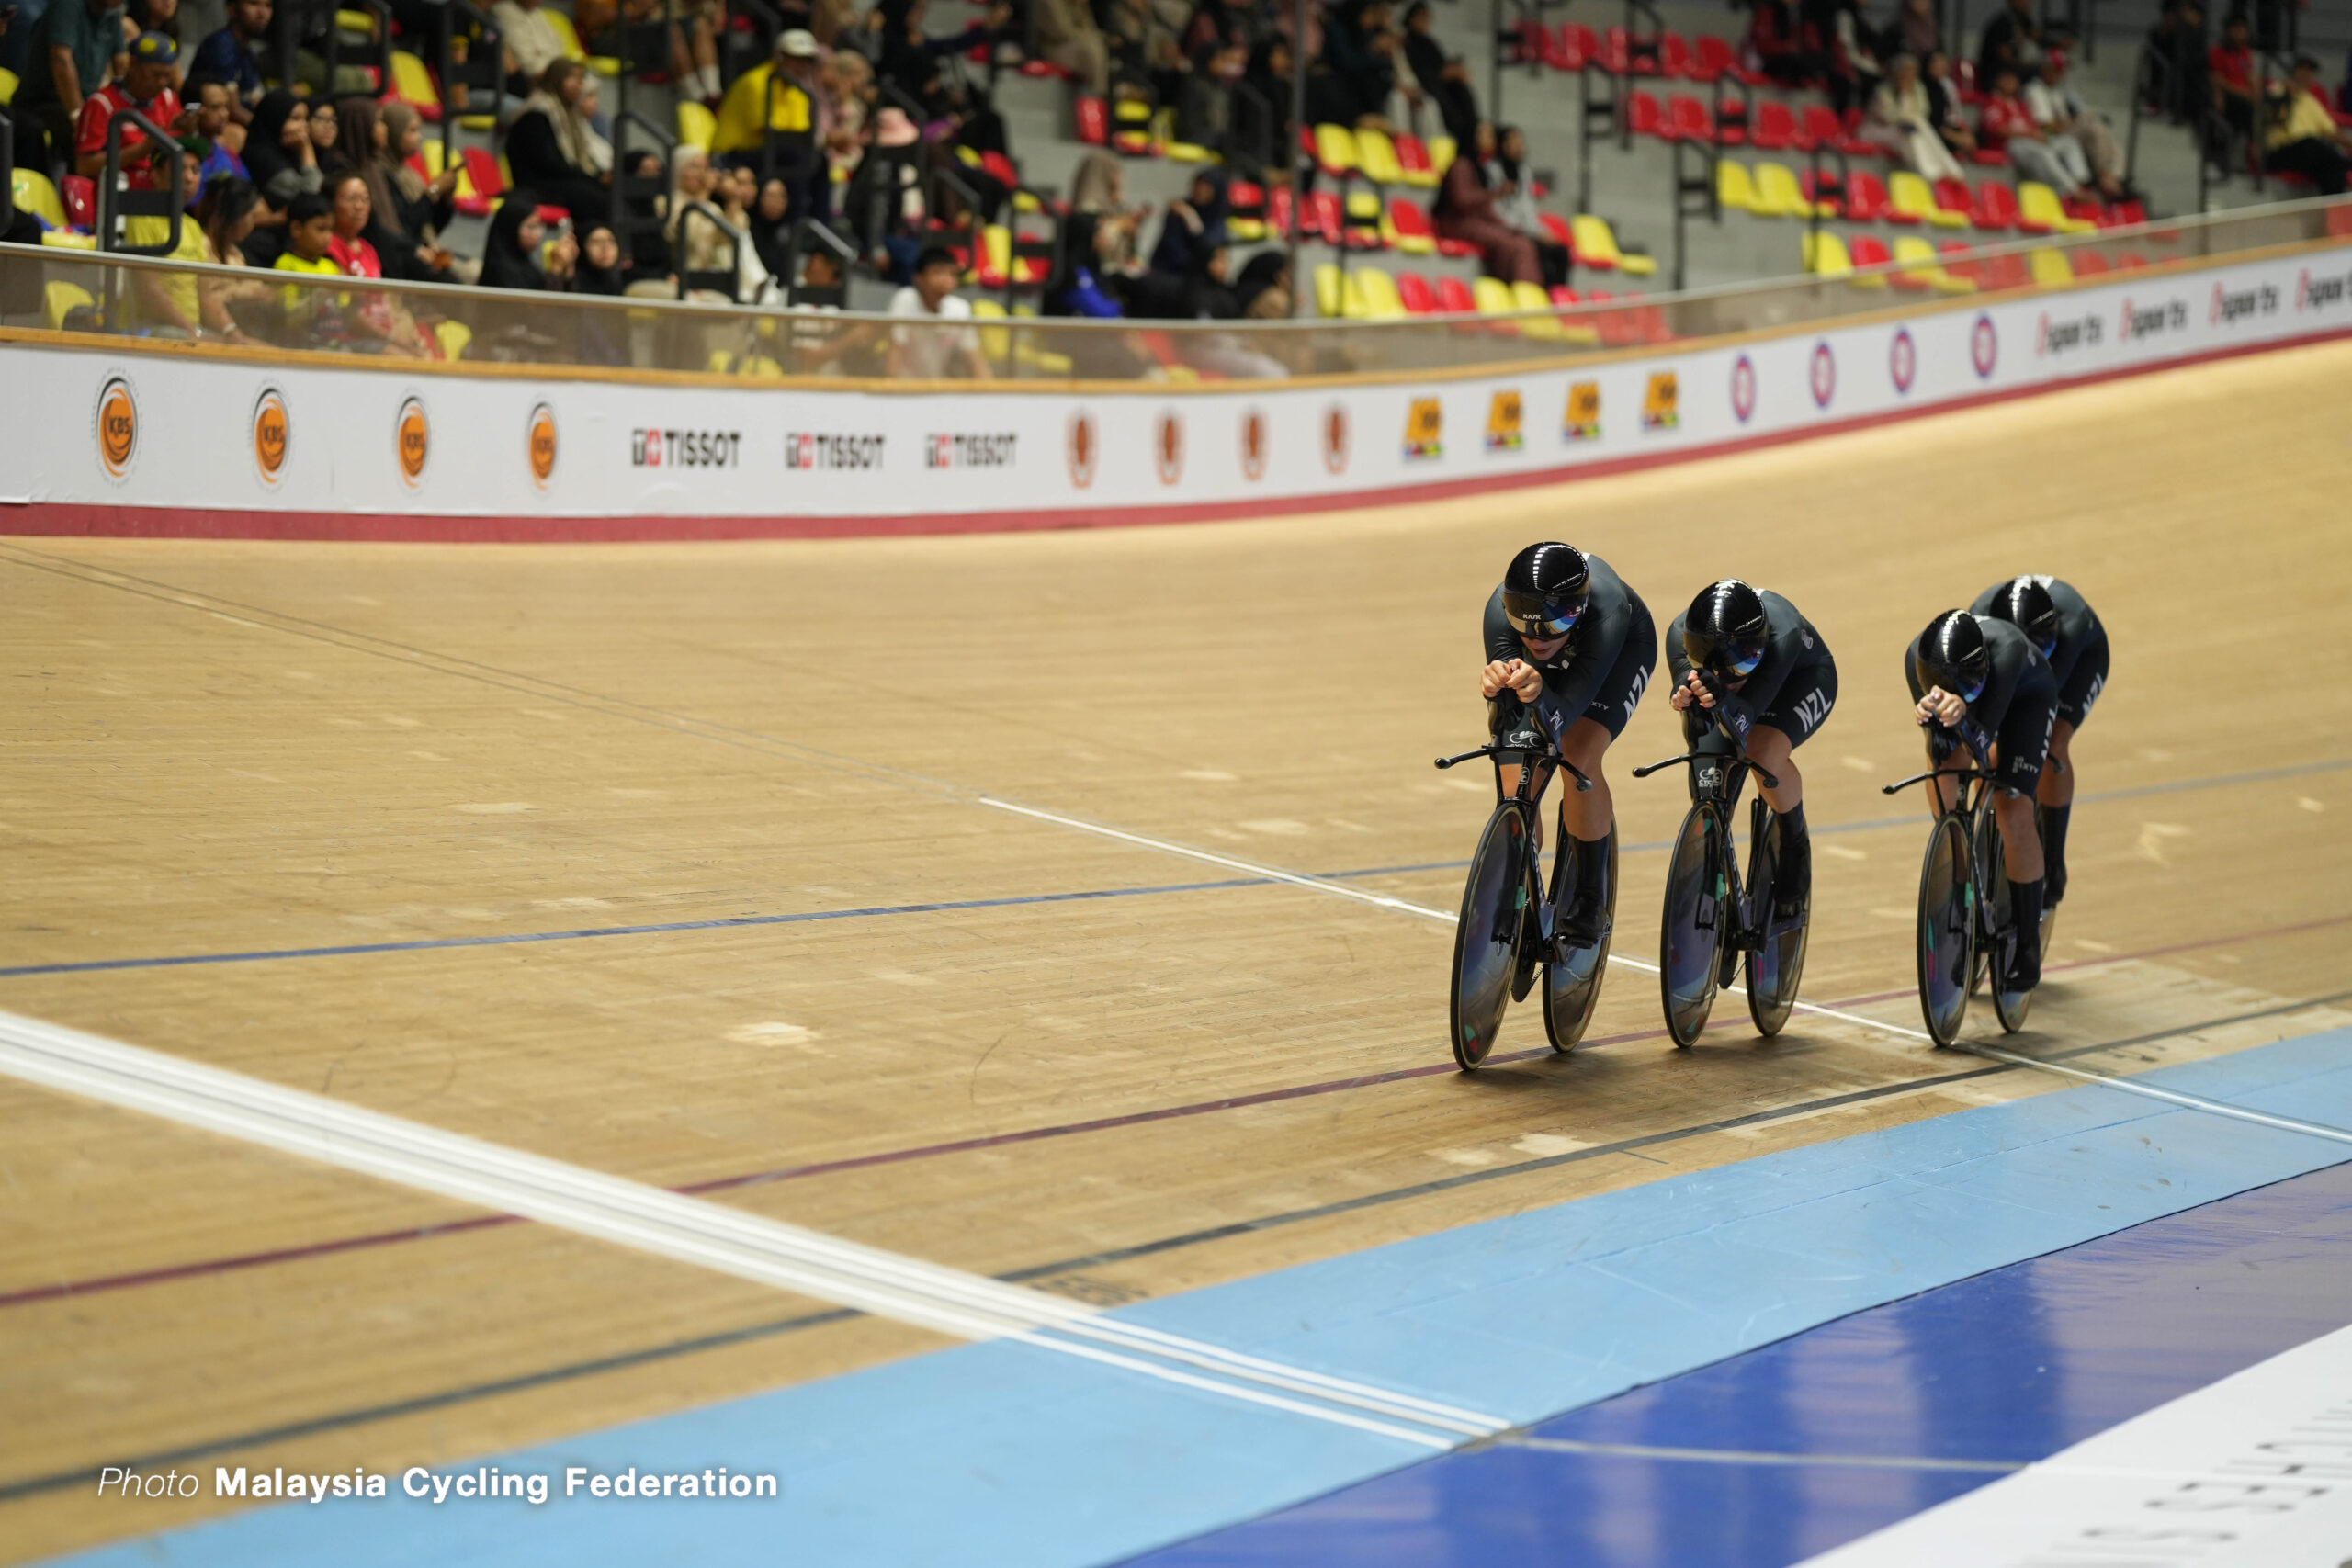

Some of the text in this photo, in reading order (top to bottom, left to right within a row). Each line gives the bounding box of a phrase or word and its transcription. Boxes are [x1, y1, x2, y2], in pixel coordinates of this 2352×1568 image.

[109, 416, 132, 434] KBS
[664, 430, 741, 467] TISSOT
[815, 434, 886, 469] TISSOT
[953, 433, 1017, 467] TISSOT
[1793, 687, 1833, 733] NZL
